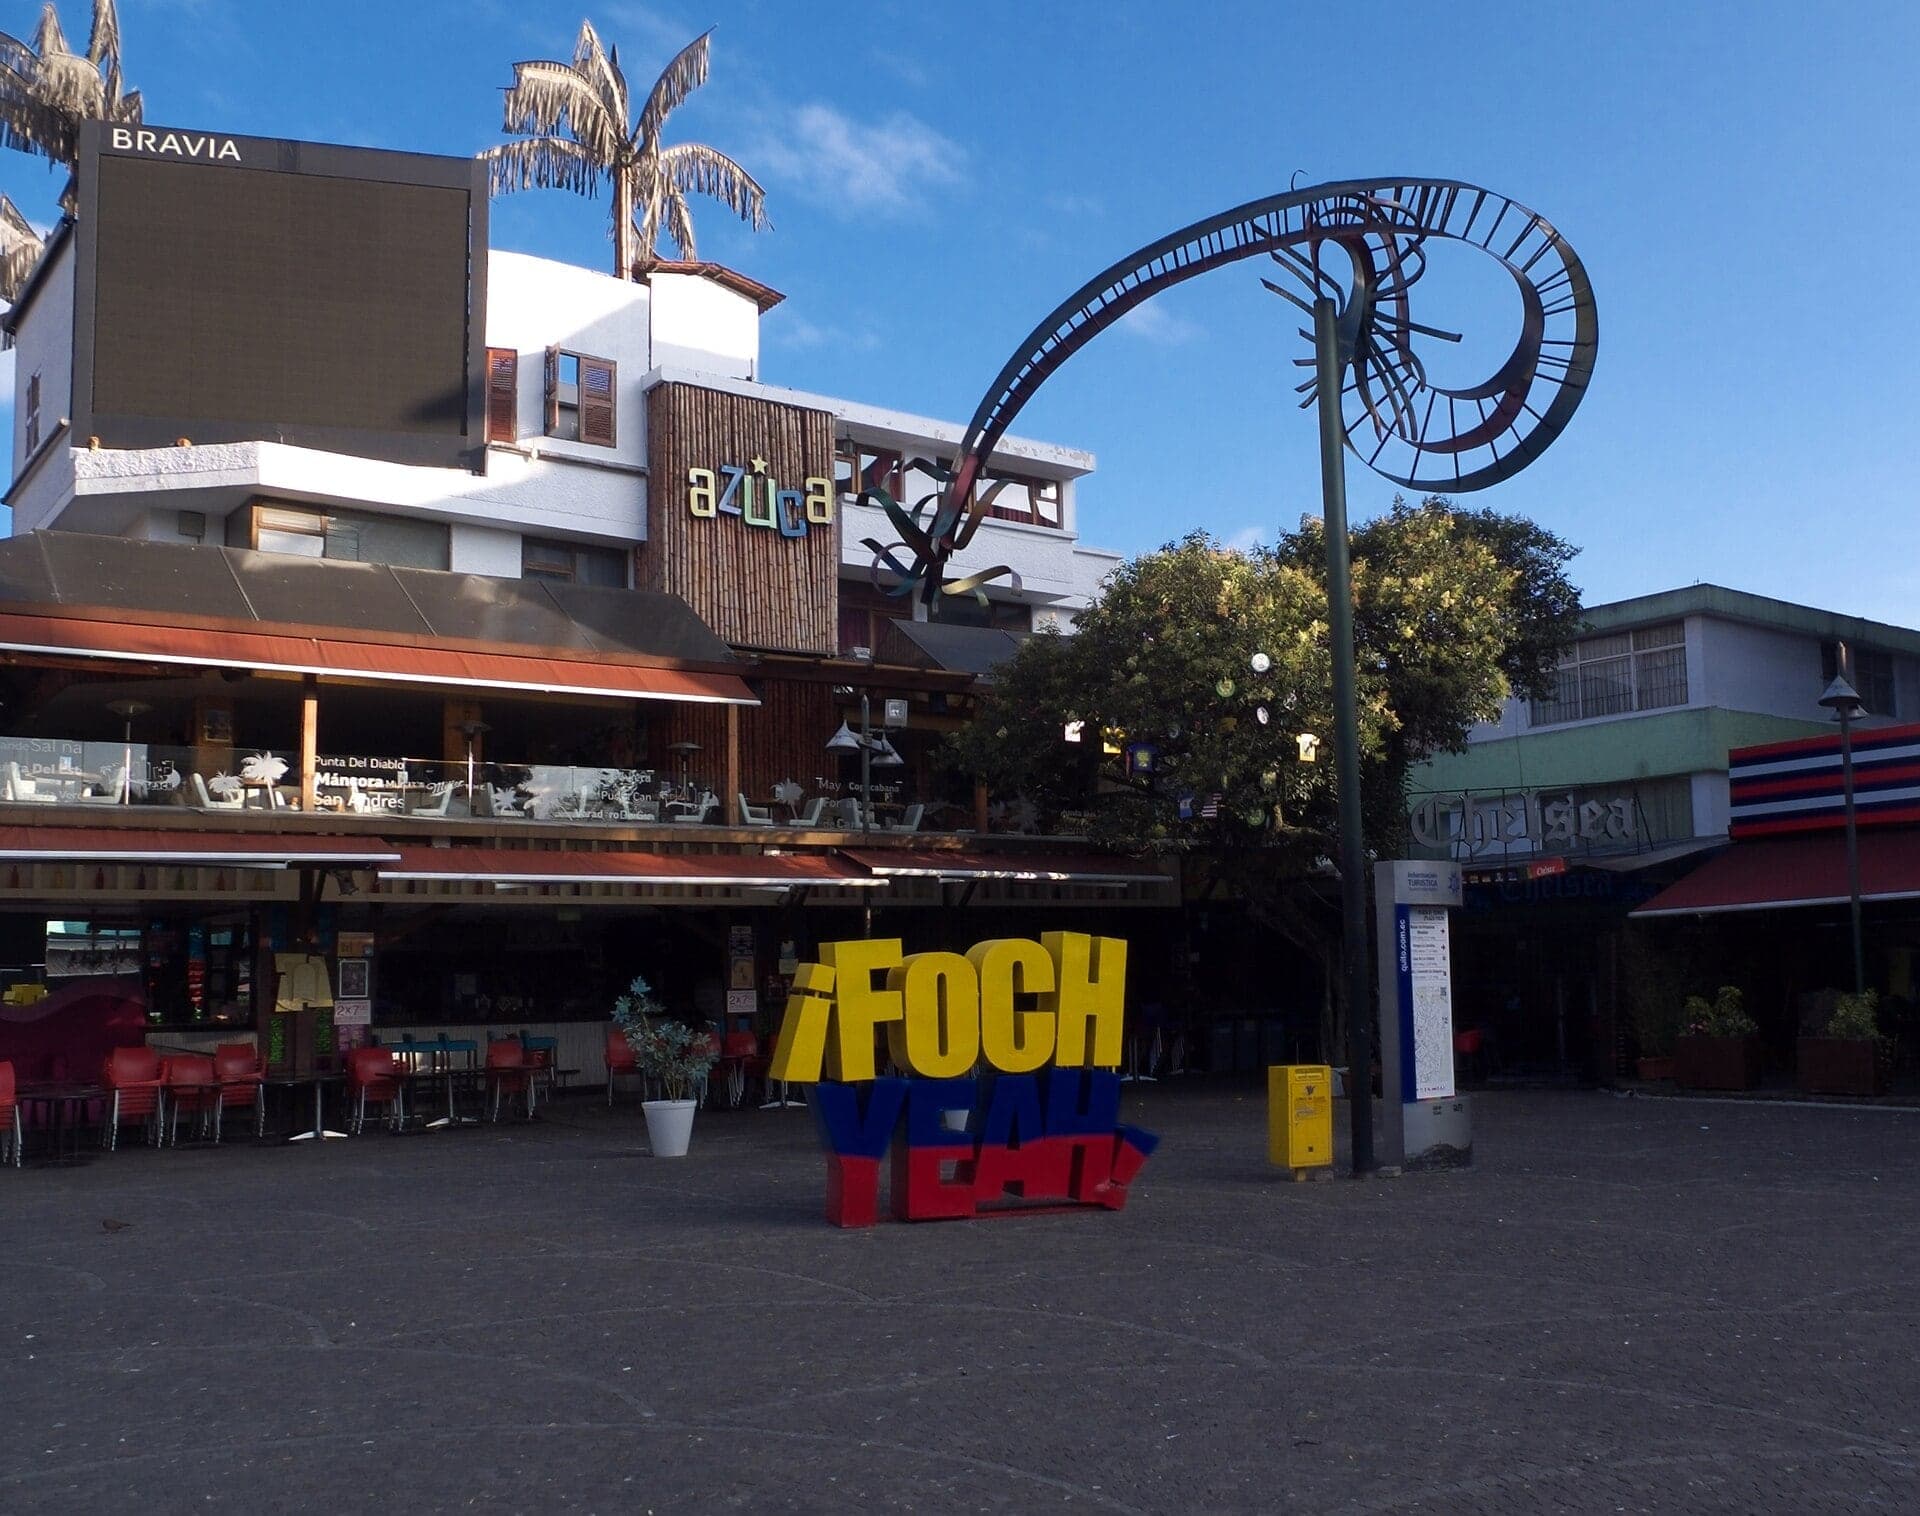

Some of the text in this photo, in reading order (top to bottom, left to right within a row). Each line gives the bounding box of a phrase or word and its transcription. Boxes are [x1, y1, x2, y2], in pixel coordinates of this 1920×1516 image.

[112, 127, 242, 161] BRAVIA
[348, 757, 368, 769] Del
[370, 759, 404, 771] Diablo
[314, 792, 344, 806] San
[1410, 791, 1638, 857] Chelsea
[1400, 919, 1409, 972] quito.com.ec
[769, 930, 1129, 1083] ¡FOCH
[803, 1066, 1160, 1230] YEAH!
